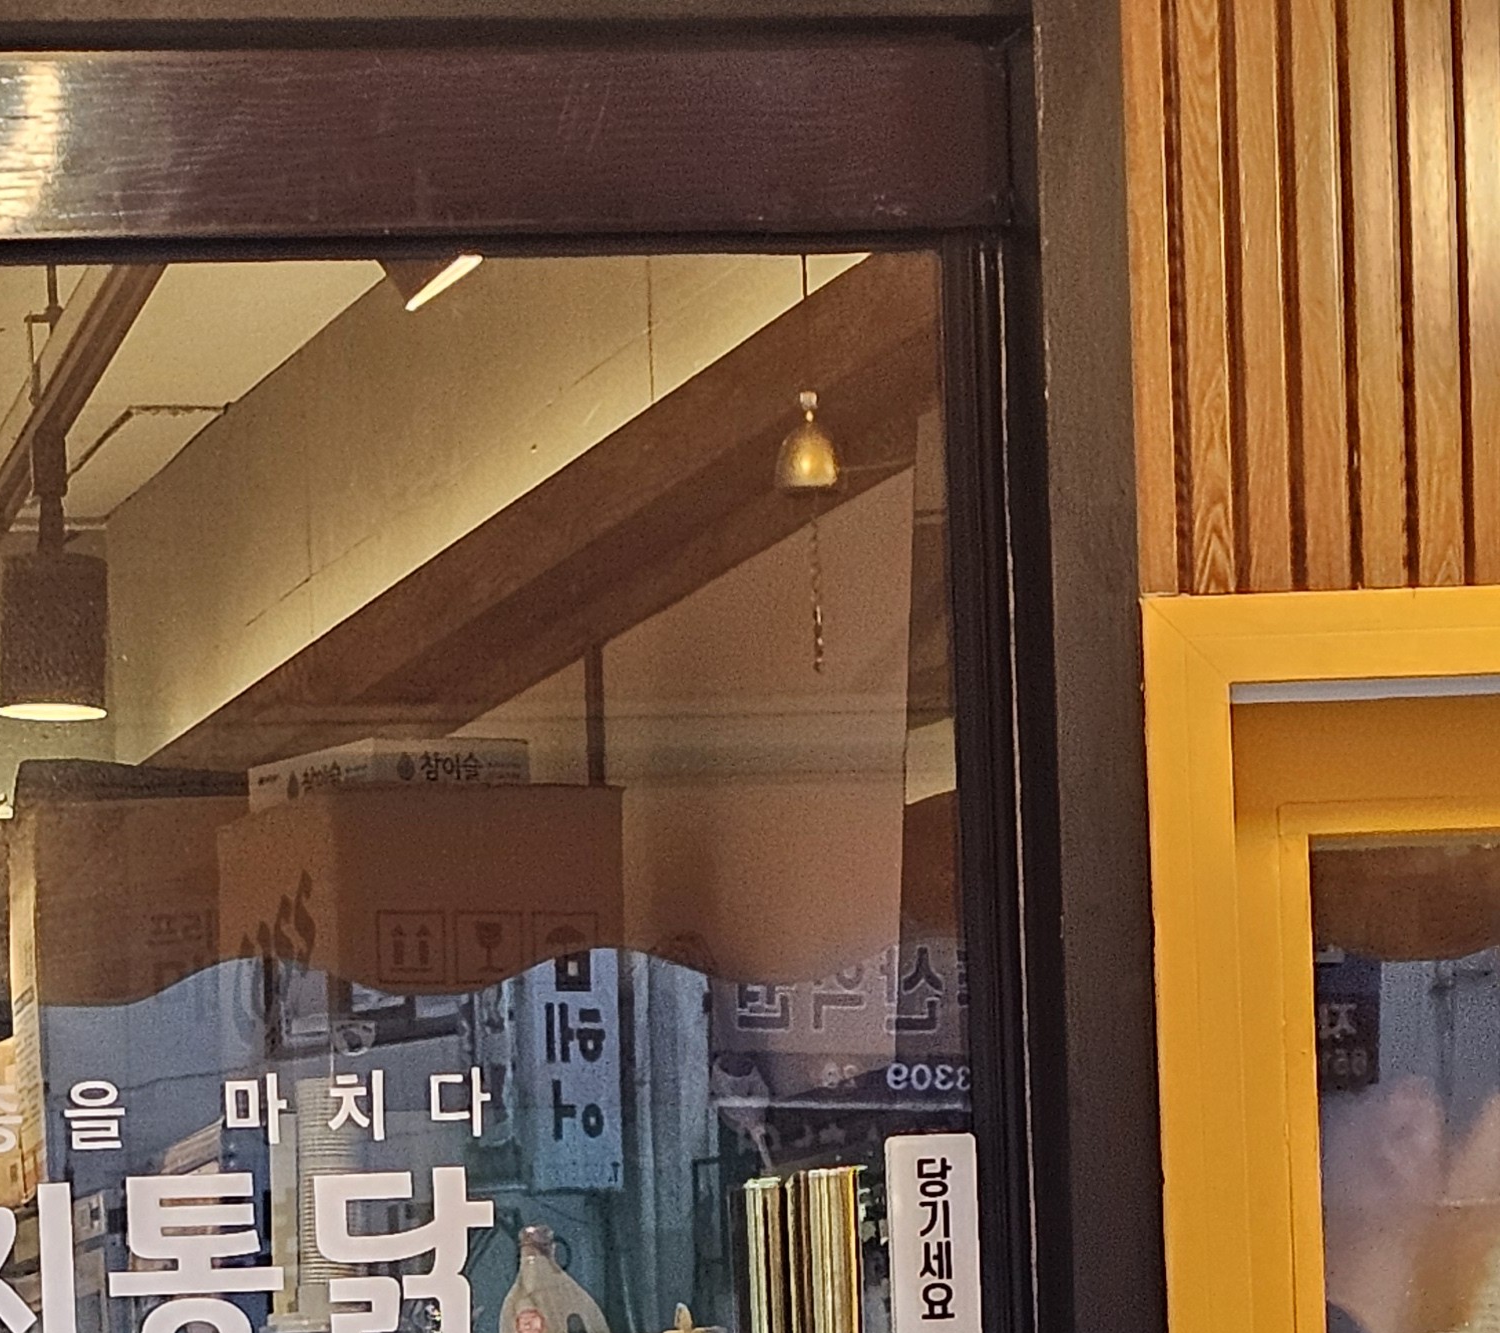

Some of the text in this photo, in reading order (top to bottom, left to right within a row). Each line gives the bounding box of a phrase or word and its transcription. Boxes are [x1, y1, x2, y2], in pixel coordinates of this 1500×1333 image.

[421, 750, 483, 781] 참이슬
[224, 1066, 492, 1145] 마치다
[916, 1156, 956, 1320] 당기세요
